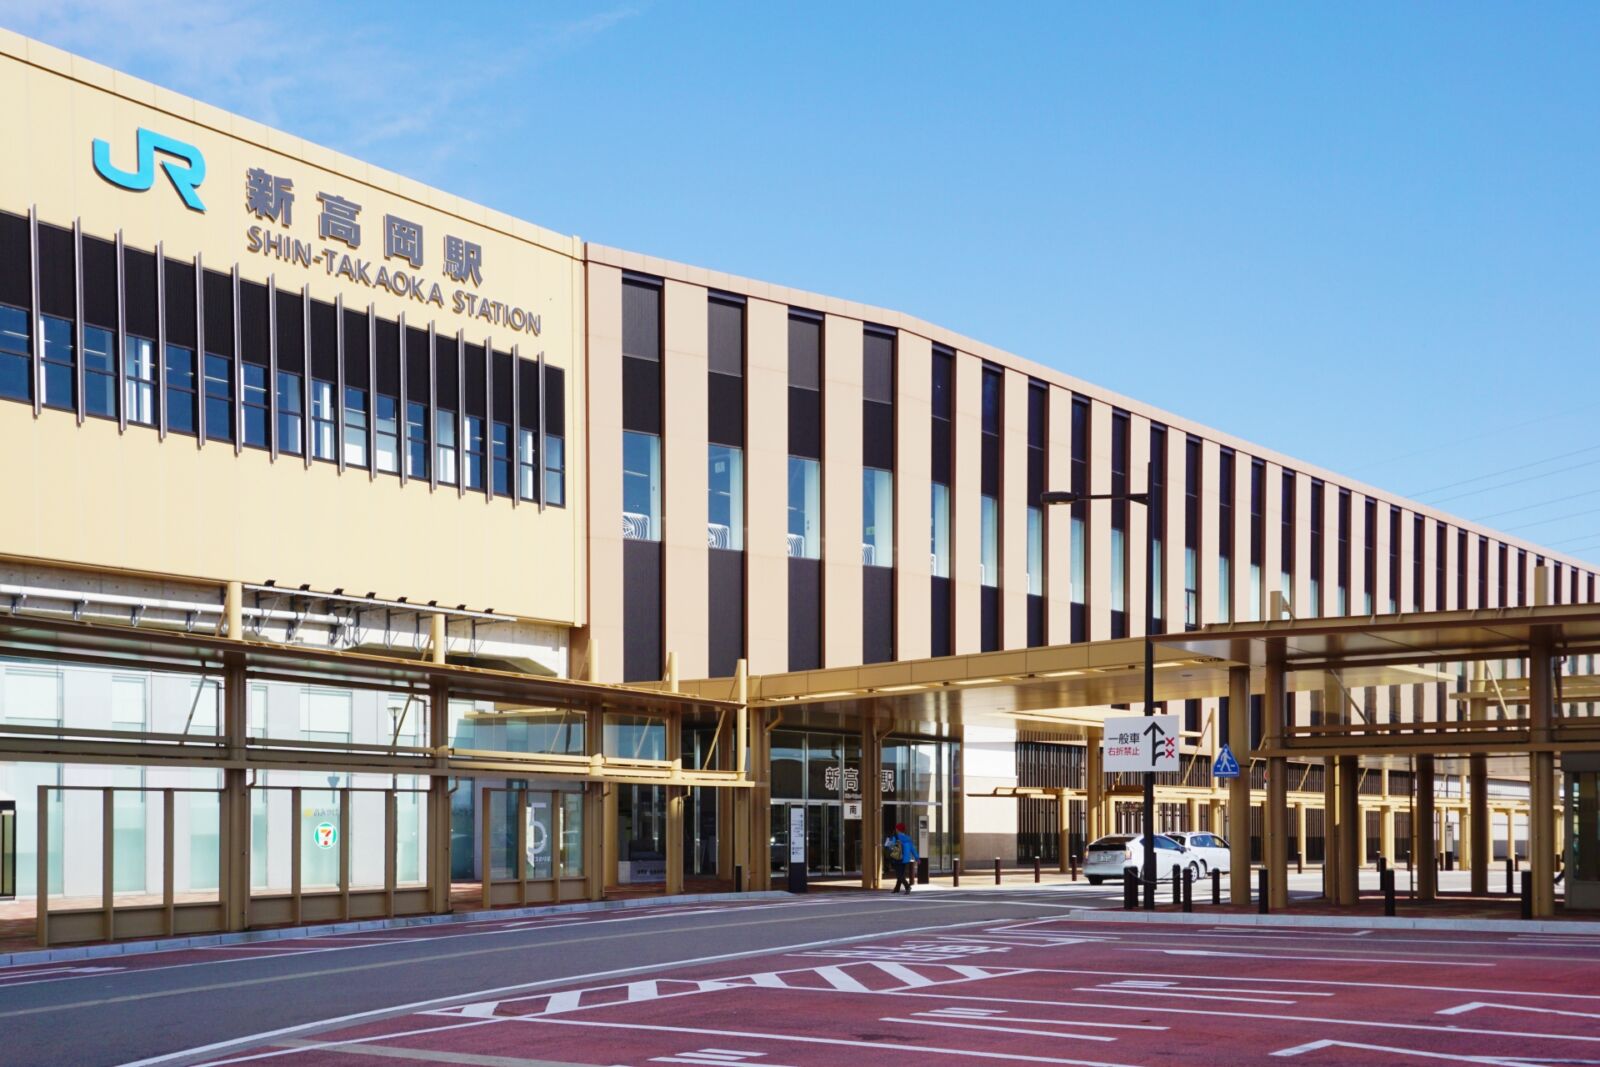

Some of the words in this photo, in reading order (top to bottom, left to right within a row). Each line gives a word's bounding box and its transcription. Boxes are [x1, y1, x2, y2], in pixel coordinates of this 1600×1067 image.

[92, 127, 207, 213] JR
[245, 166, 484, 287] 新高岡駅
[246, 224, 444, 308] SHIN-TAKAOKA
[452, 290, 543, 336] STATION
[1108, 733, 1140, 744] 一般車
[1108, 747, 1140, 756] 右折禁止
[825, 766, 895, 793] 新高駅
